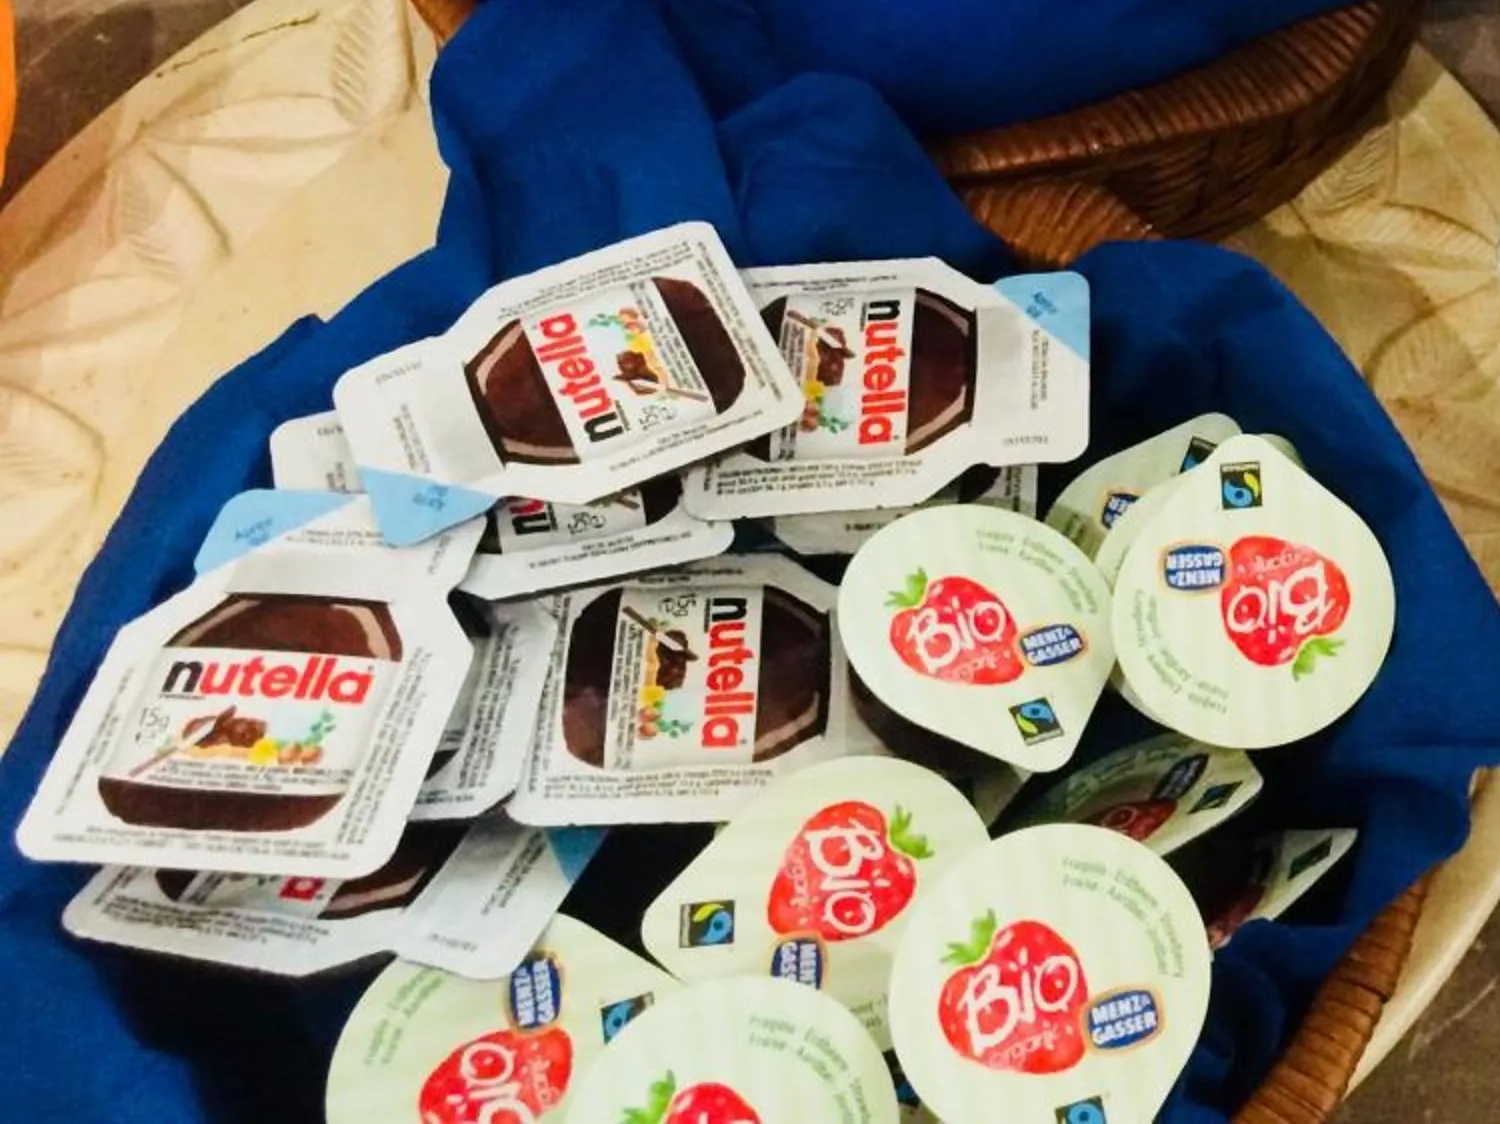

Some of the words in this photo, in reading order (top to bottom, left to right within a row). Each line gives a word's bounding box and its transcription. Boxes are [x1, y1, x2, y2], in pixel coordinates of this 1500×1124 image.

[534, 312, 625, 444] nutella
[858, 299, 909, 446] nutella
[1167, 550, 1224, 570] GASSER
[700, 596, 756, 749] nutella
[1026, 638, 1083, 664] GASSER
[161, 655, 376, 705] nutella
[1091, 1011, 1158, 1045] GASSER
